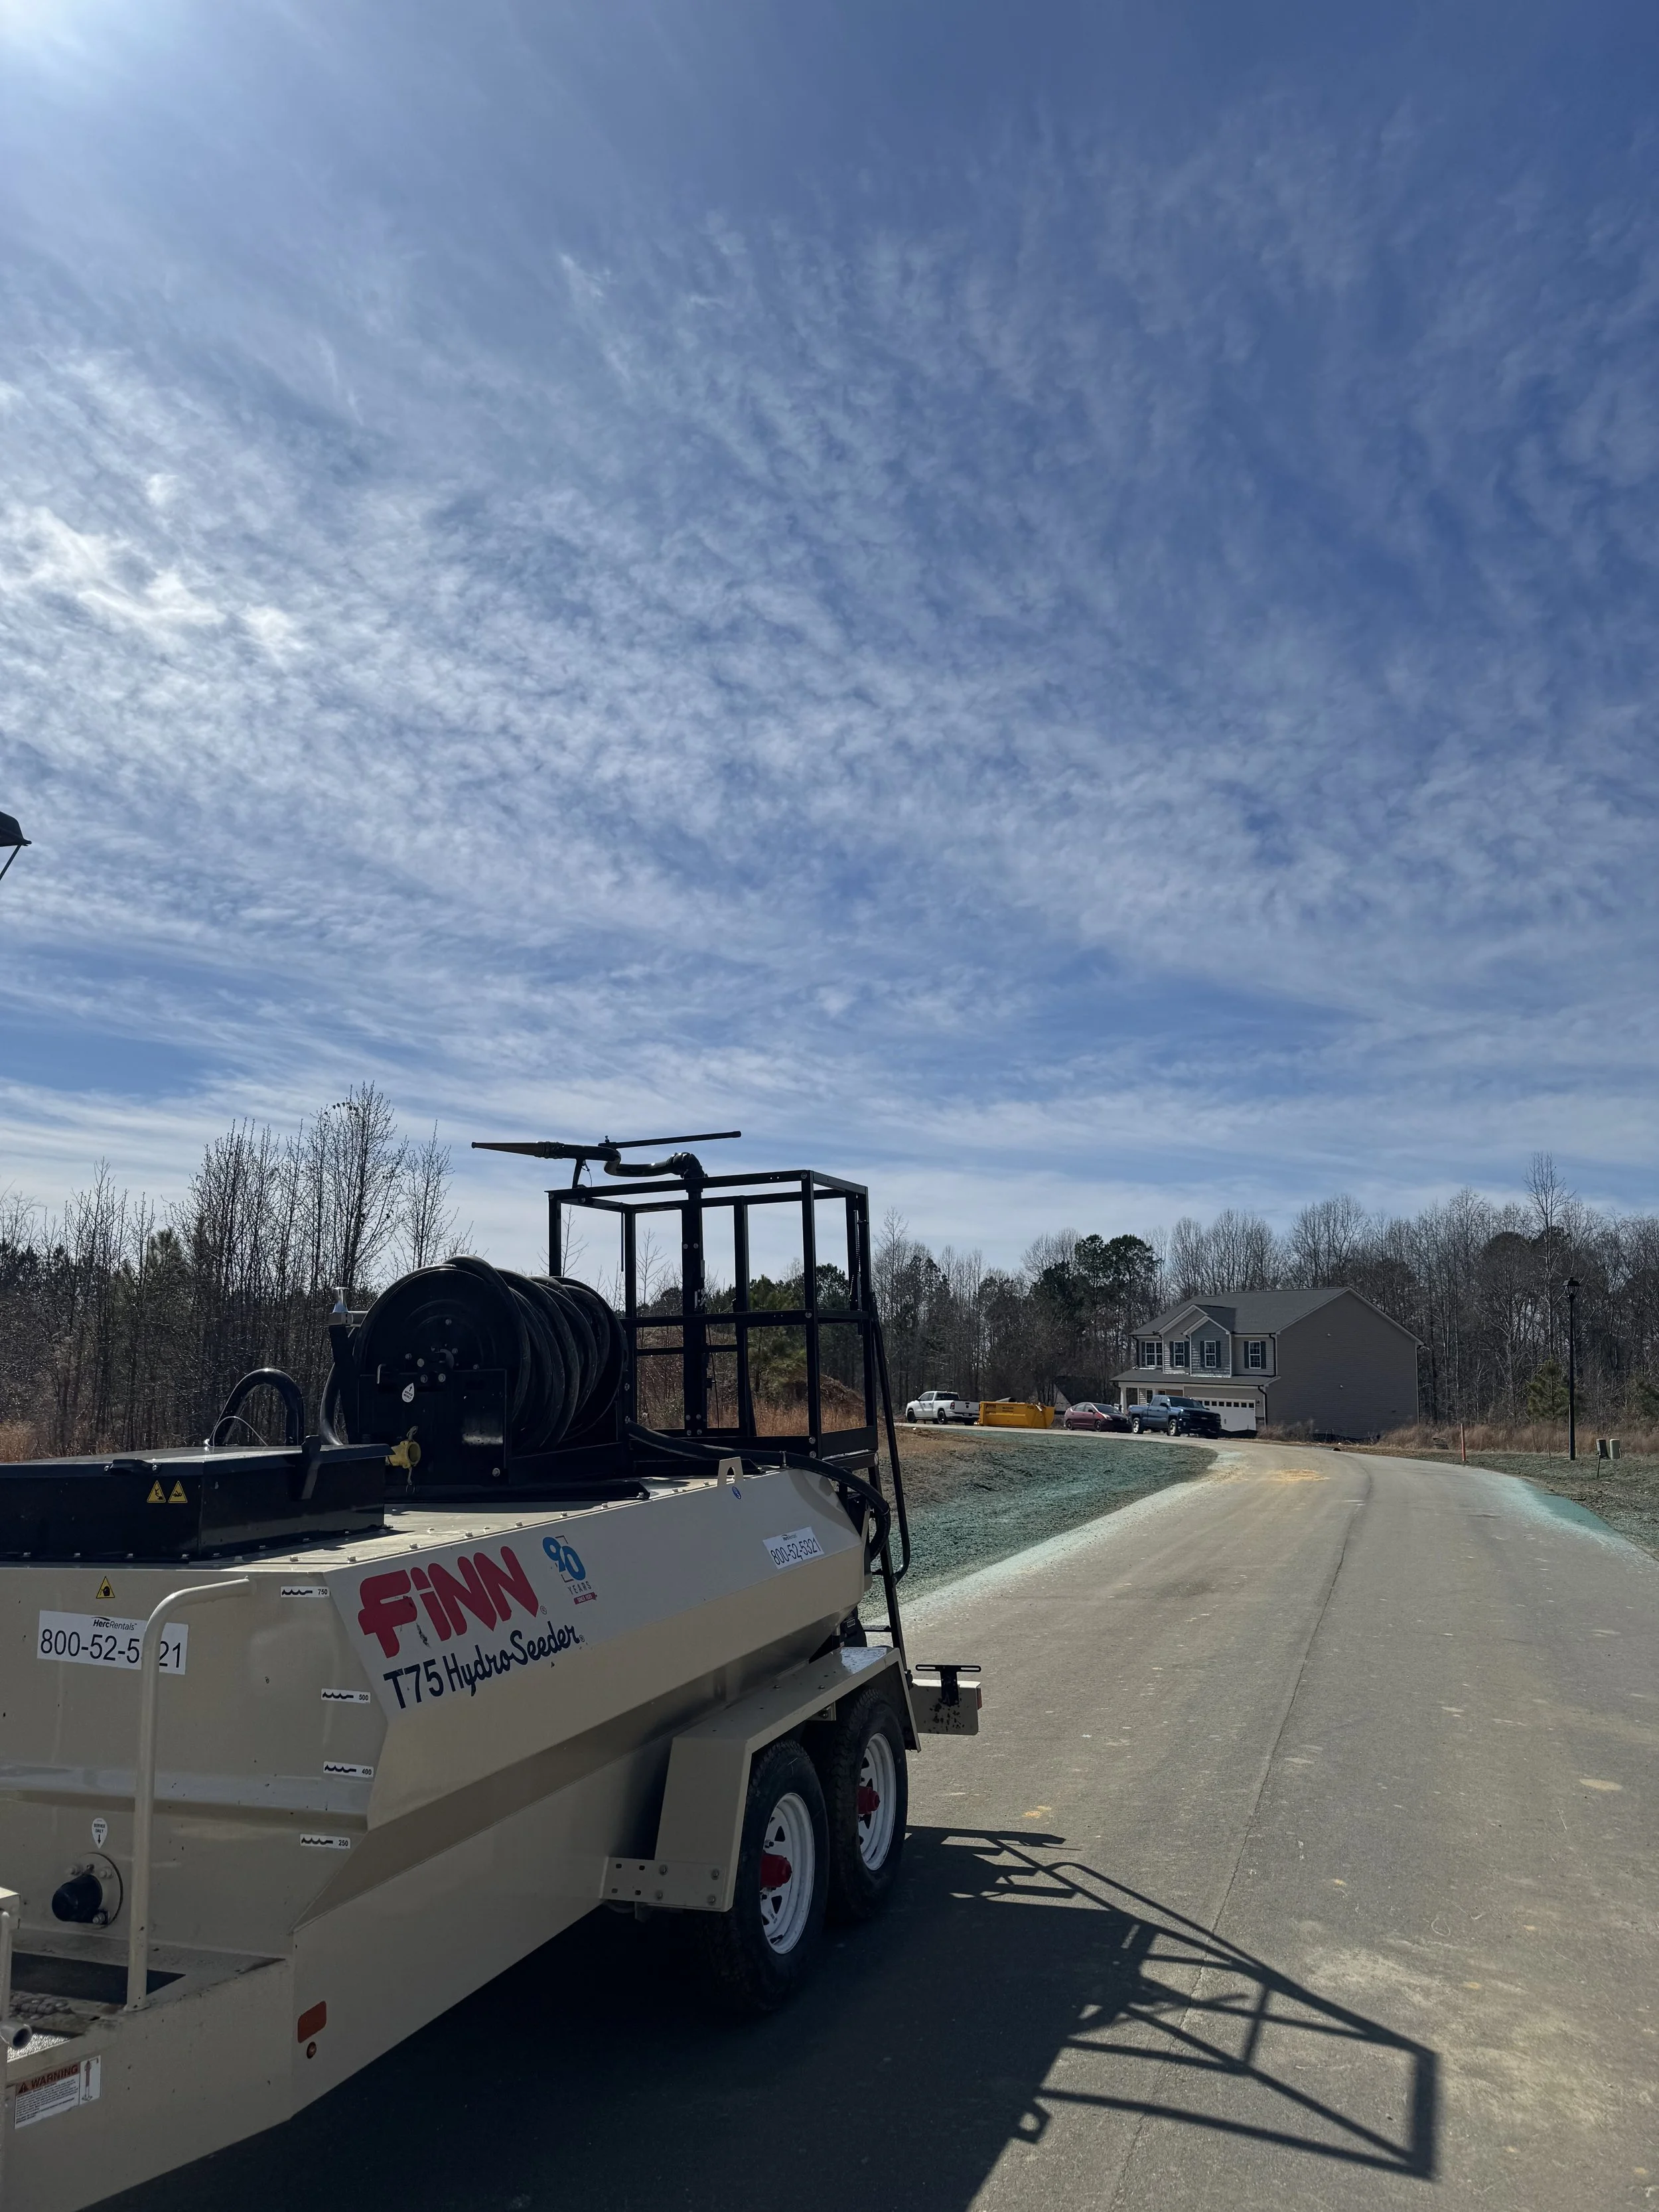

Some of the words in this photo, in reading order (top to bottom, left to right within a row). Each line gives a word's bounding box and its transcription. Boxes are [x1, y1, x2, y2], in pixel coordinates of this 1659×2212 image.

[542, 1536, 586, 1581] 90
[770, 1537, 822, 1566] 800-52-5321
[568, 1581, 592, 1595] YEARS
[40, 1629, 181, 1668] 800-52-521
[383, 1659, 444, 1709] T75
[443, 1621, 581, 1697] HydroSeeder
[31, 2065, 78, 2089] WARNING
